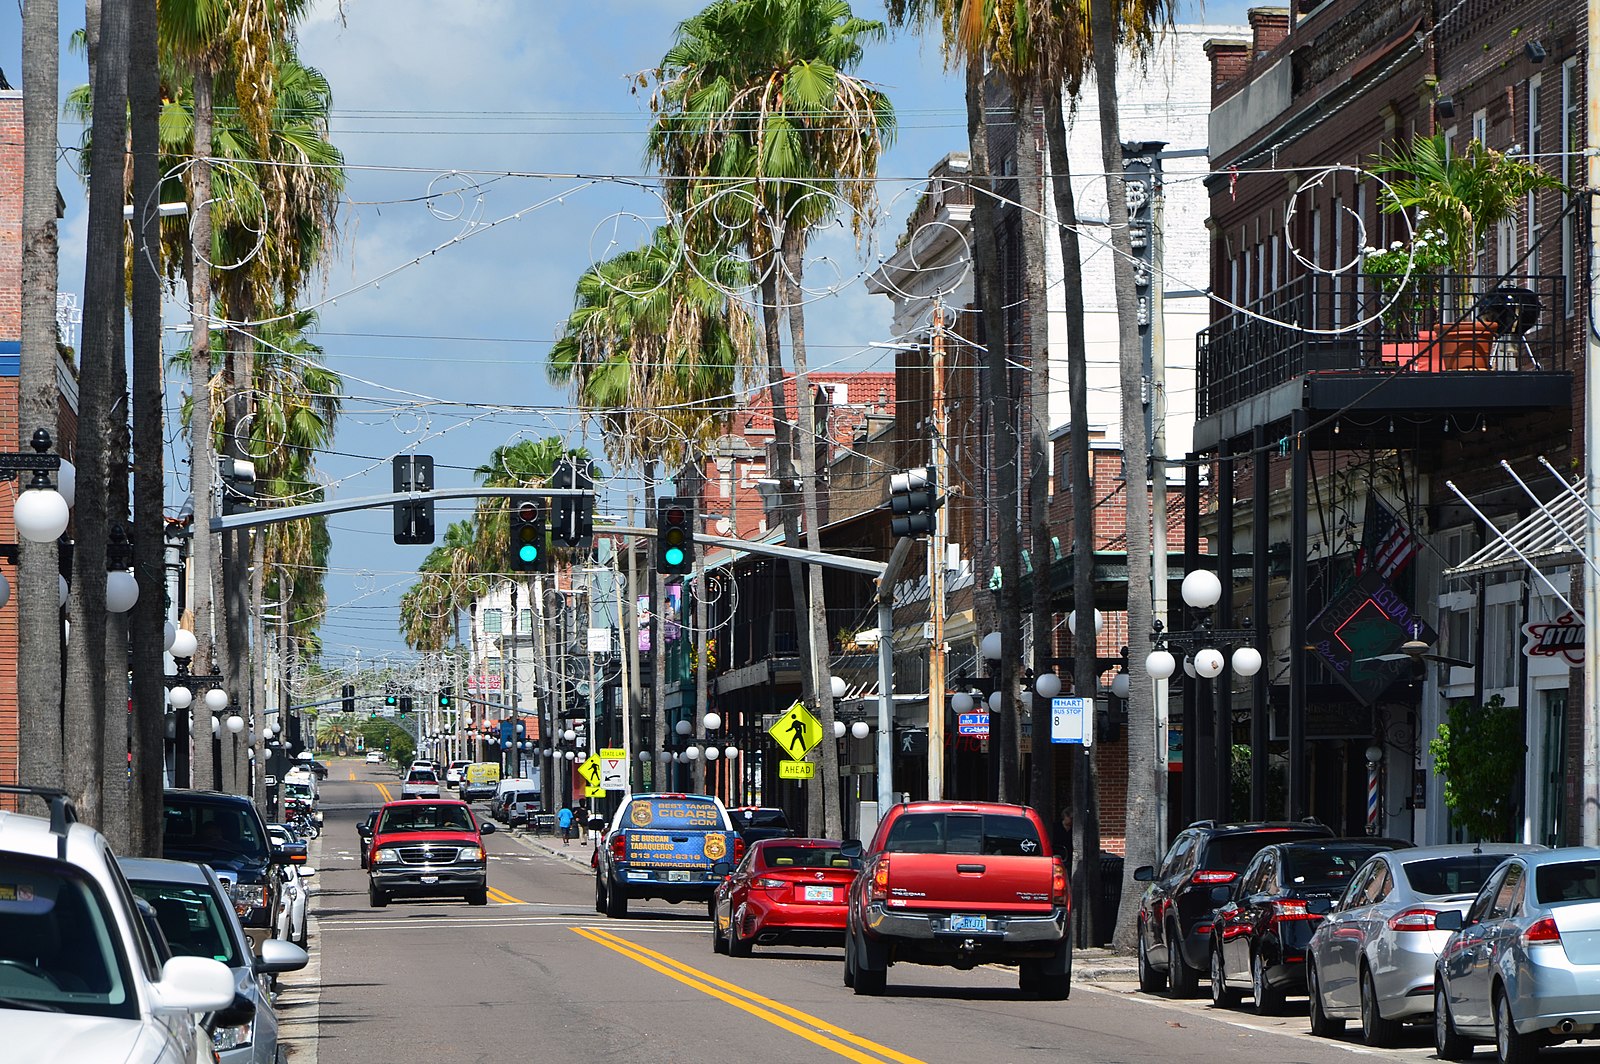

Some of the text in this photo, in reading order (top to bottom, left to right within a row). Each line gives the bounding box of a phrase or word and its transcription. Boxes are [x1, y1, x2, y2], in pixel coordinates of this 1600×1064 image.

[1054, 716, 1060, 726] 8
[784, 766, 811, 774] AHEAD
[658, 809, 718, 819] CIGARS
[630, 834, 640, 842] SE
[630, 842, 675, 851] TABAQUEROS
